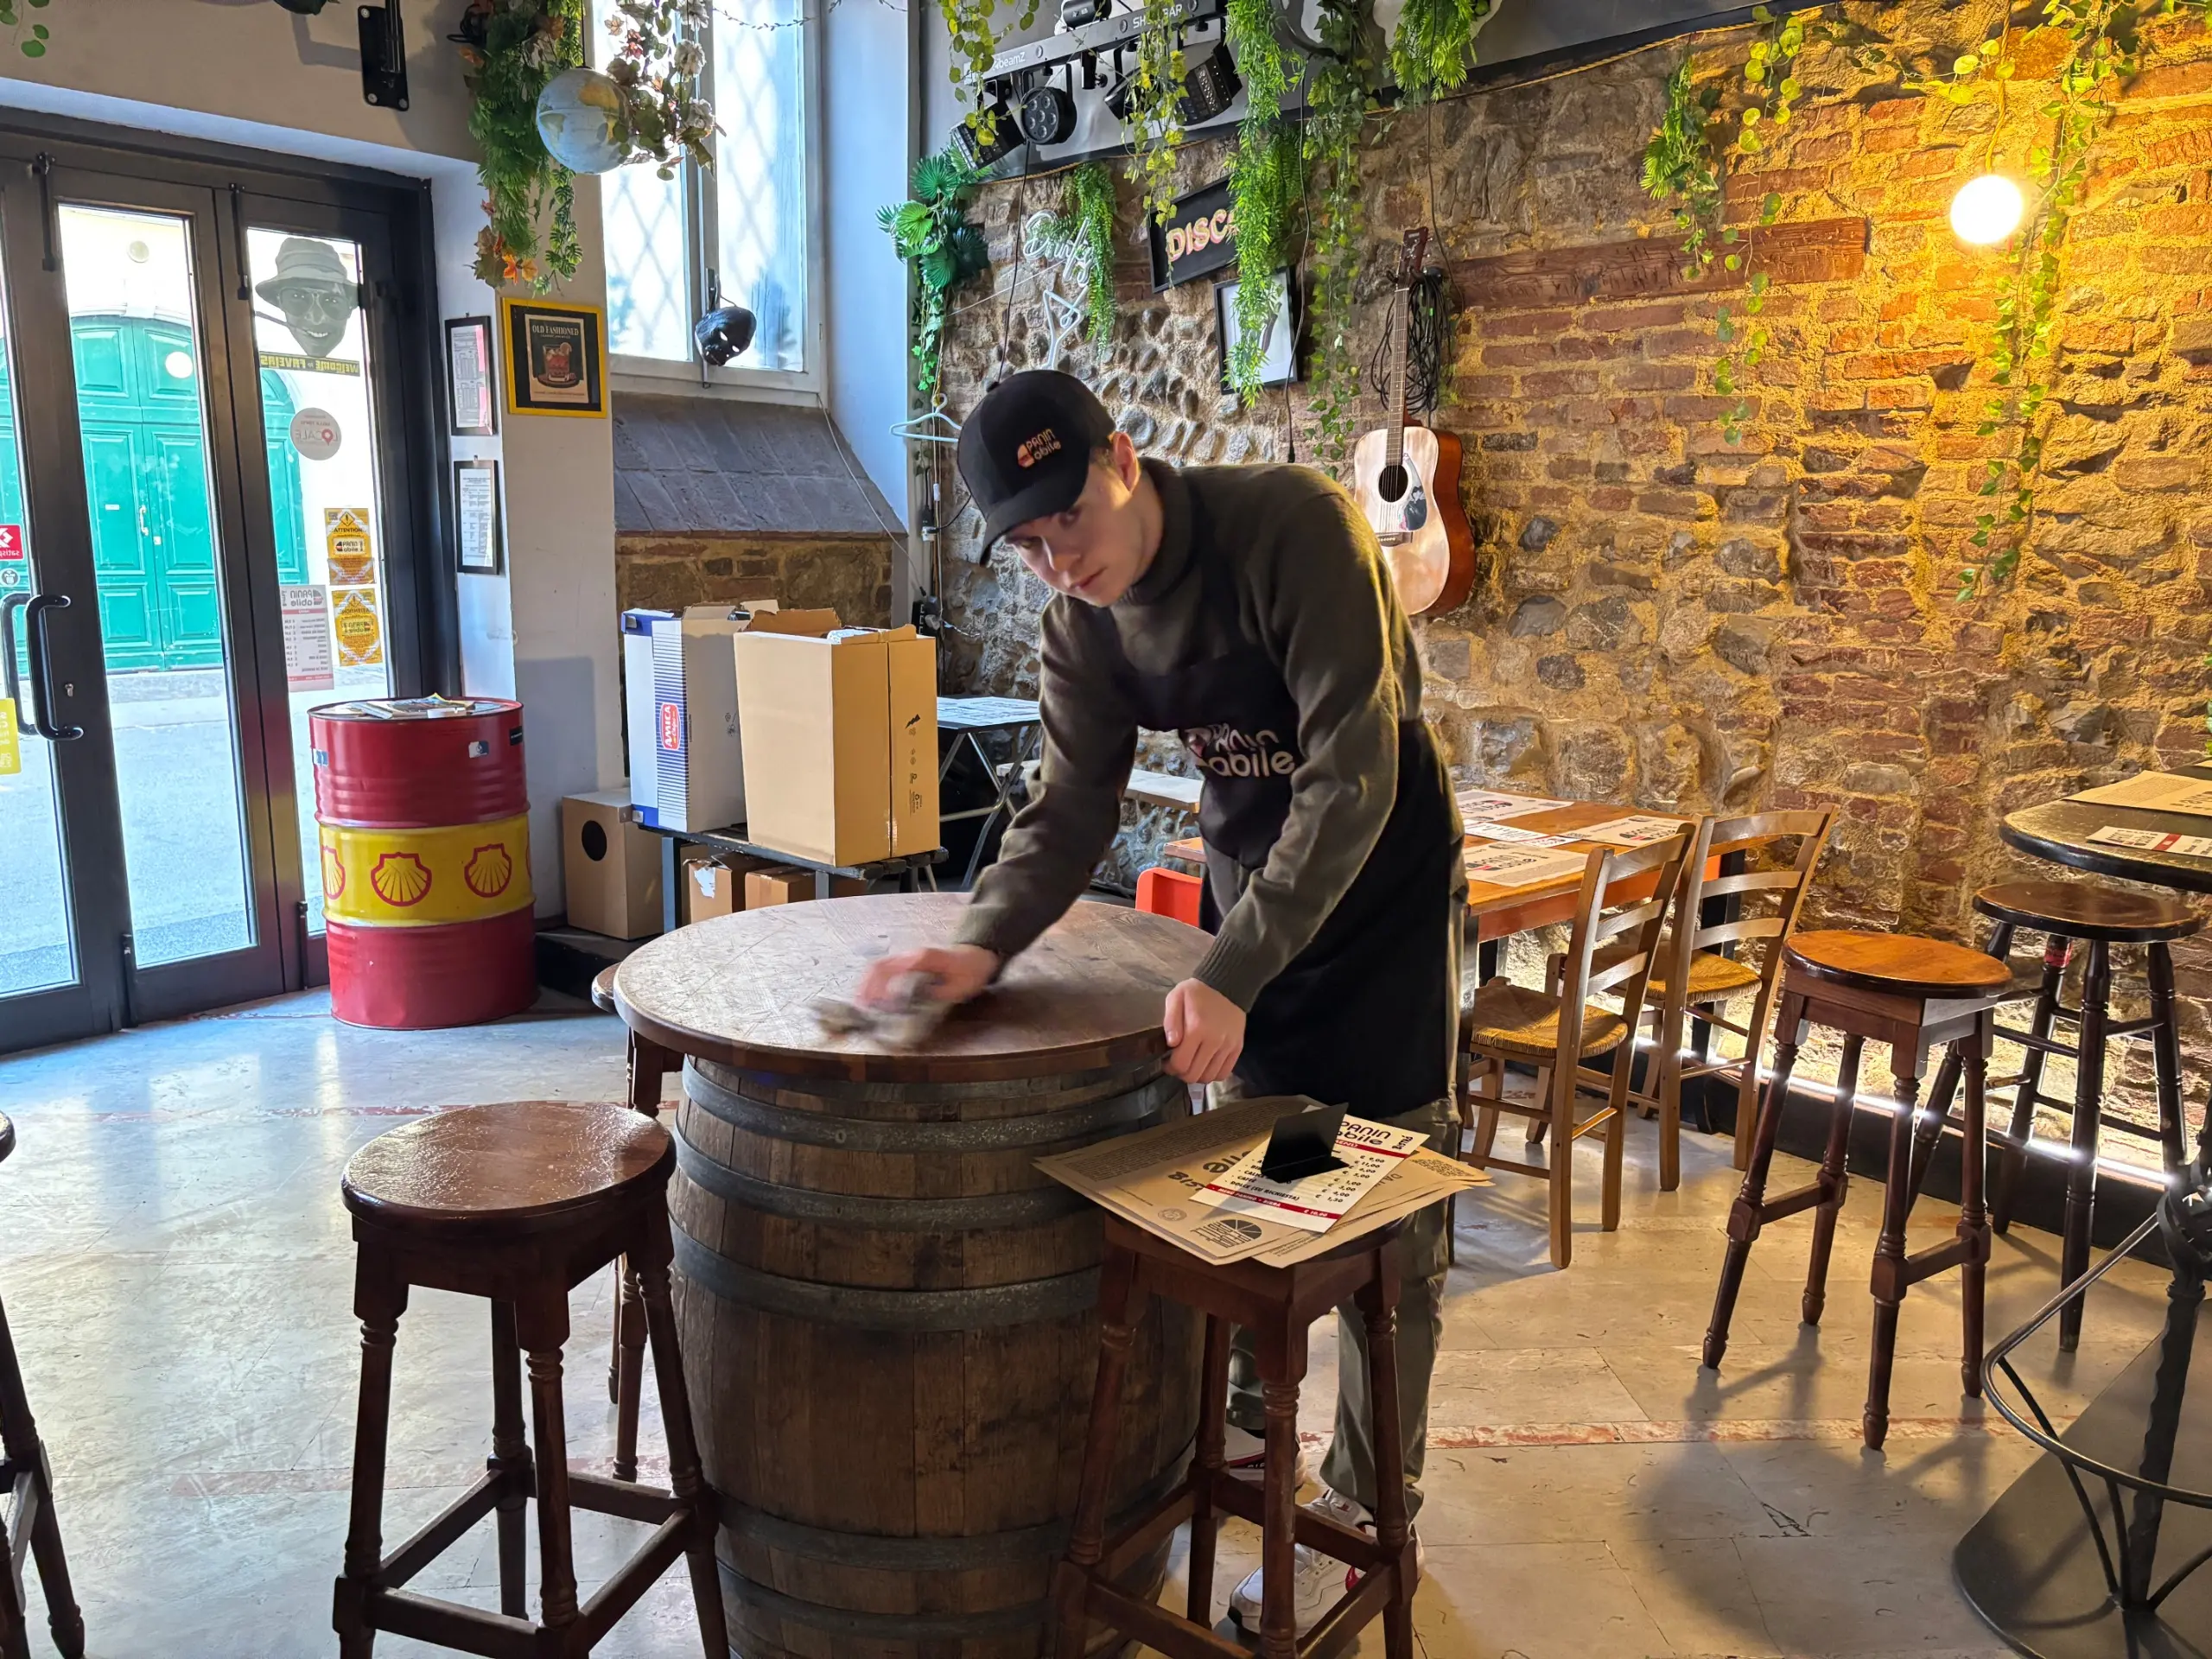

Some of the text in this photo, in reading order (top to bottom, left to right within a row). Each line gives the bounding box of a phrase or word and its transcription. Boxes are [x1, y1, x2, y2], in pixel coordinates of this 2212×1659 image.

[1133, 3, 1182, 29] SHBAR
[532, 325, 544, 334] OLD
[546, 326, 579, 336] FASHIONED
[1230, 1180, 1250, 1189] DOLCE
[1264, 1189, 1300, 1201] RICHIESTA)
